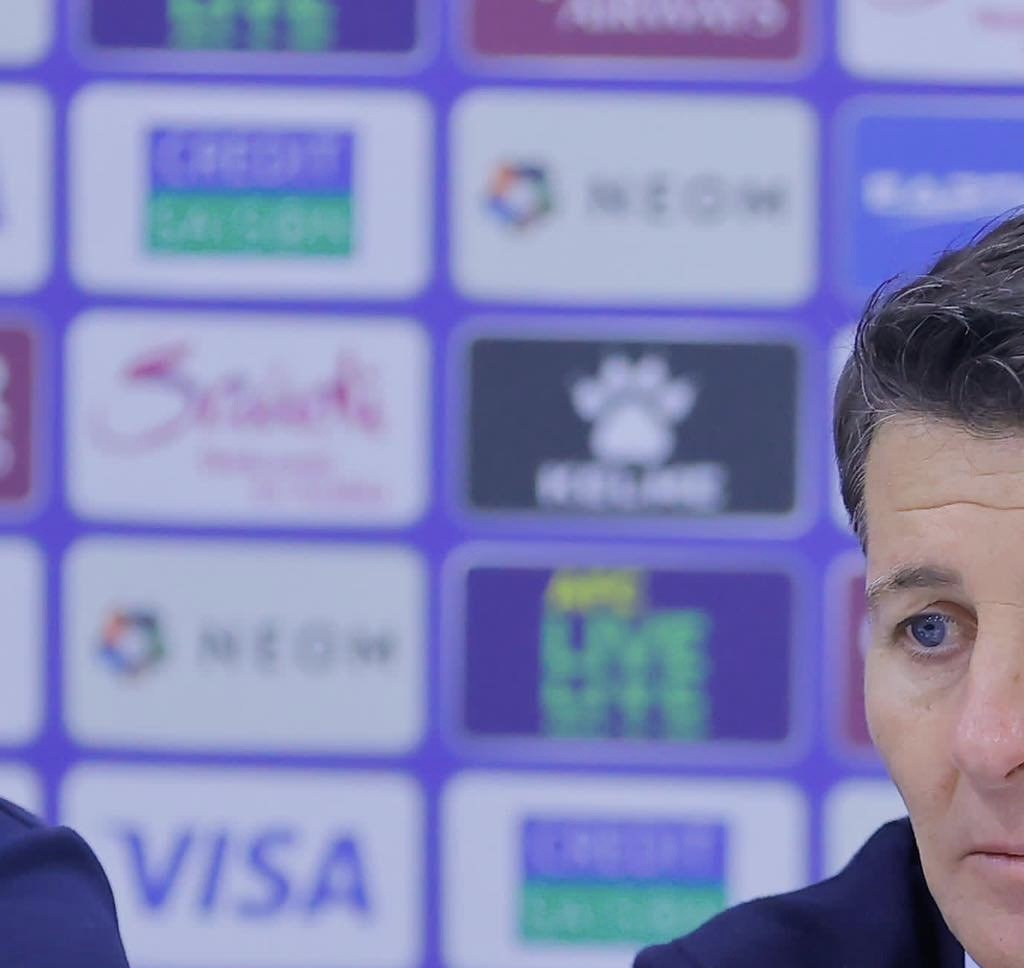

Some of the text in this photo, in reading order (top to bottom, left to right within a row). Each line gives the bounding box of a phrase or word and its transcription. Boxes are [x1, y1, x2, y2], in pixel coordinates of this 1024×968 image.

[587, 176, 788, 222] NEOM
[536, 462, 728, 510] KELME
[201, 622, 399, 674] NEOM
[541, 610, 710, 682] LIVE
[118, 830, 374, 925] VISA
